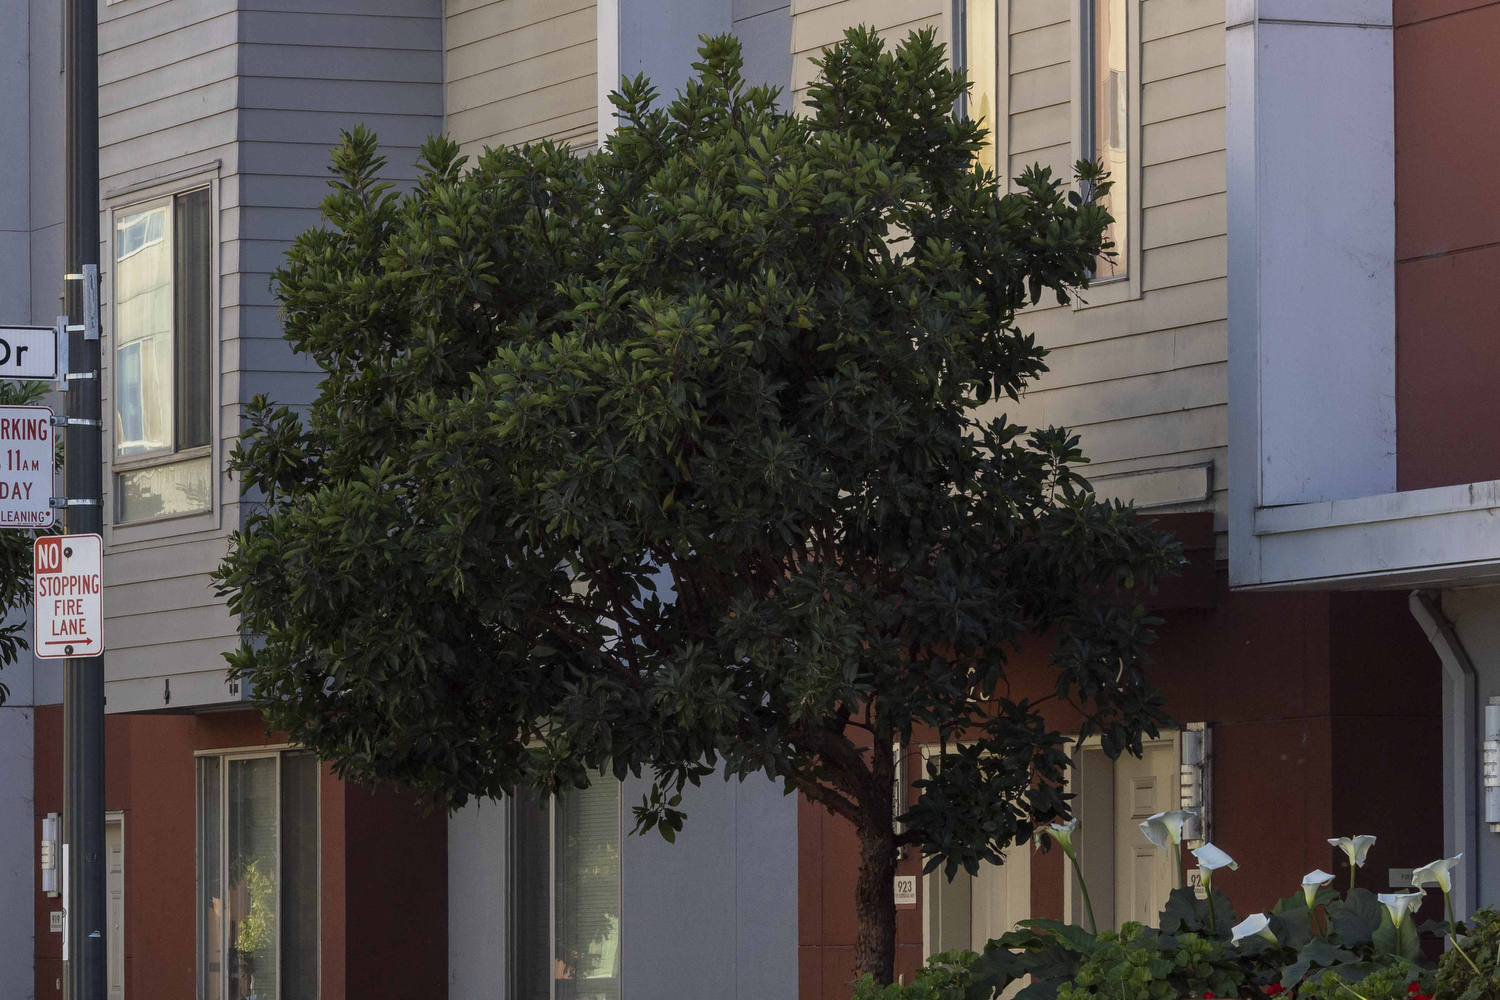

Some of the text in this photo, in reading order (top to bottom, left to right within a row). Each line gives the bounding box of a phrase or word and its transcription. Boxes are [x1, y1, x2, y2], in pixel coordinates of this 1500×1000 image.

[38, 543, 59, 570] NO
[39, 574, 99, 597] STOPPING
[54, 598, 84, 616] FIRE
[52, 618, 87, 636] LANE
[897, 880, 912, 892] 923
